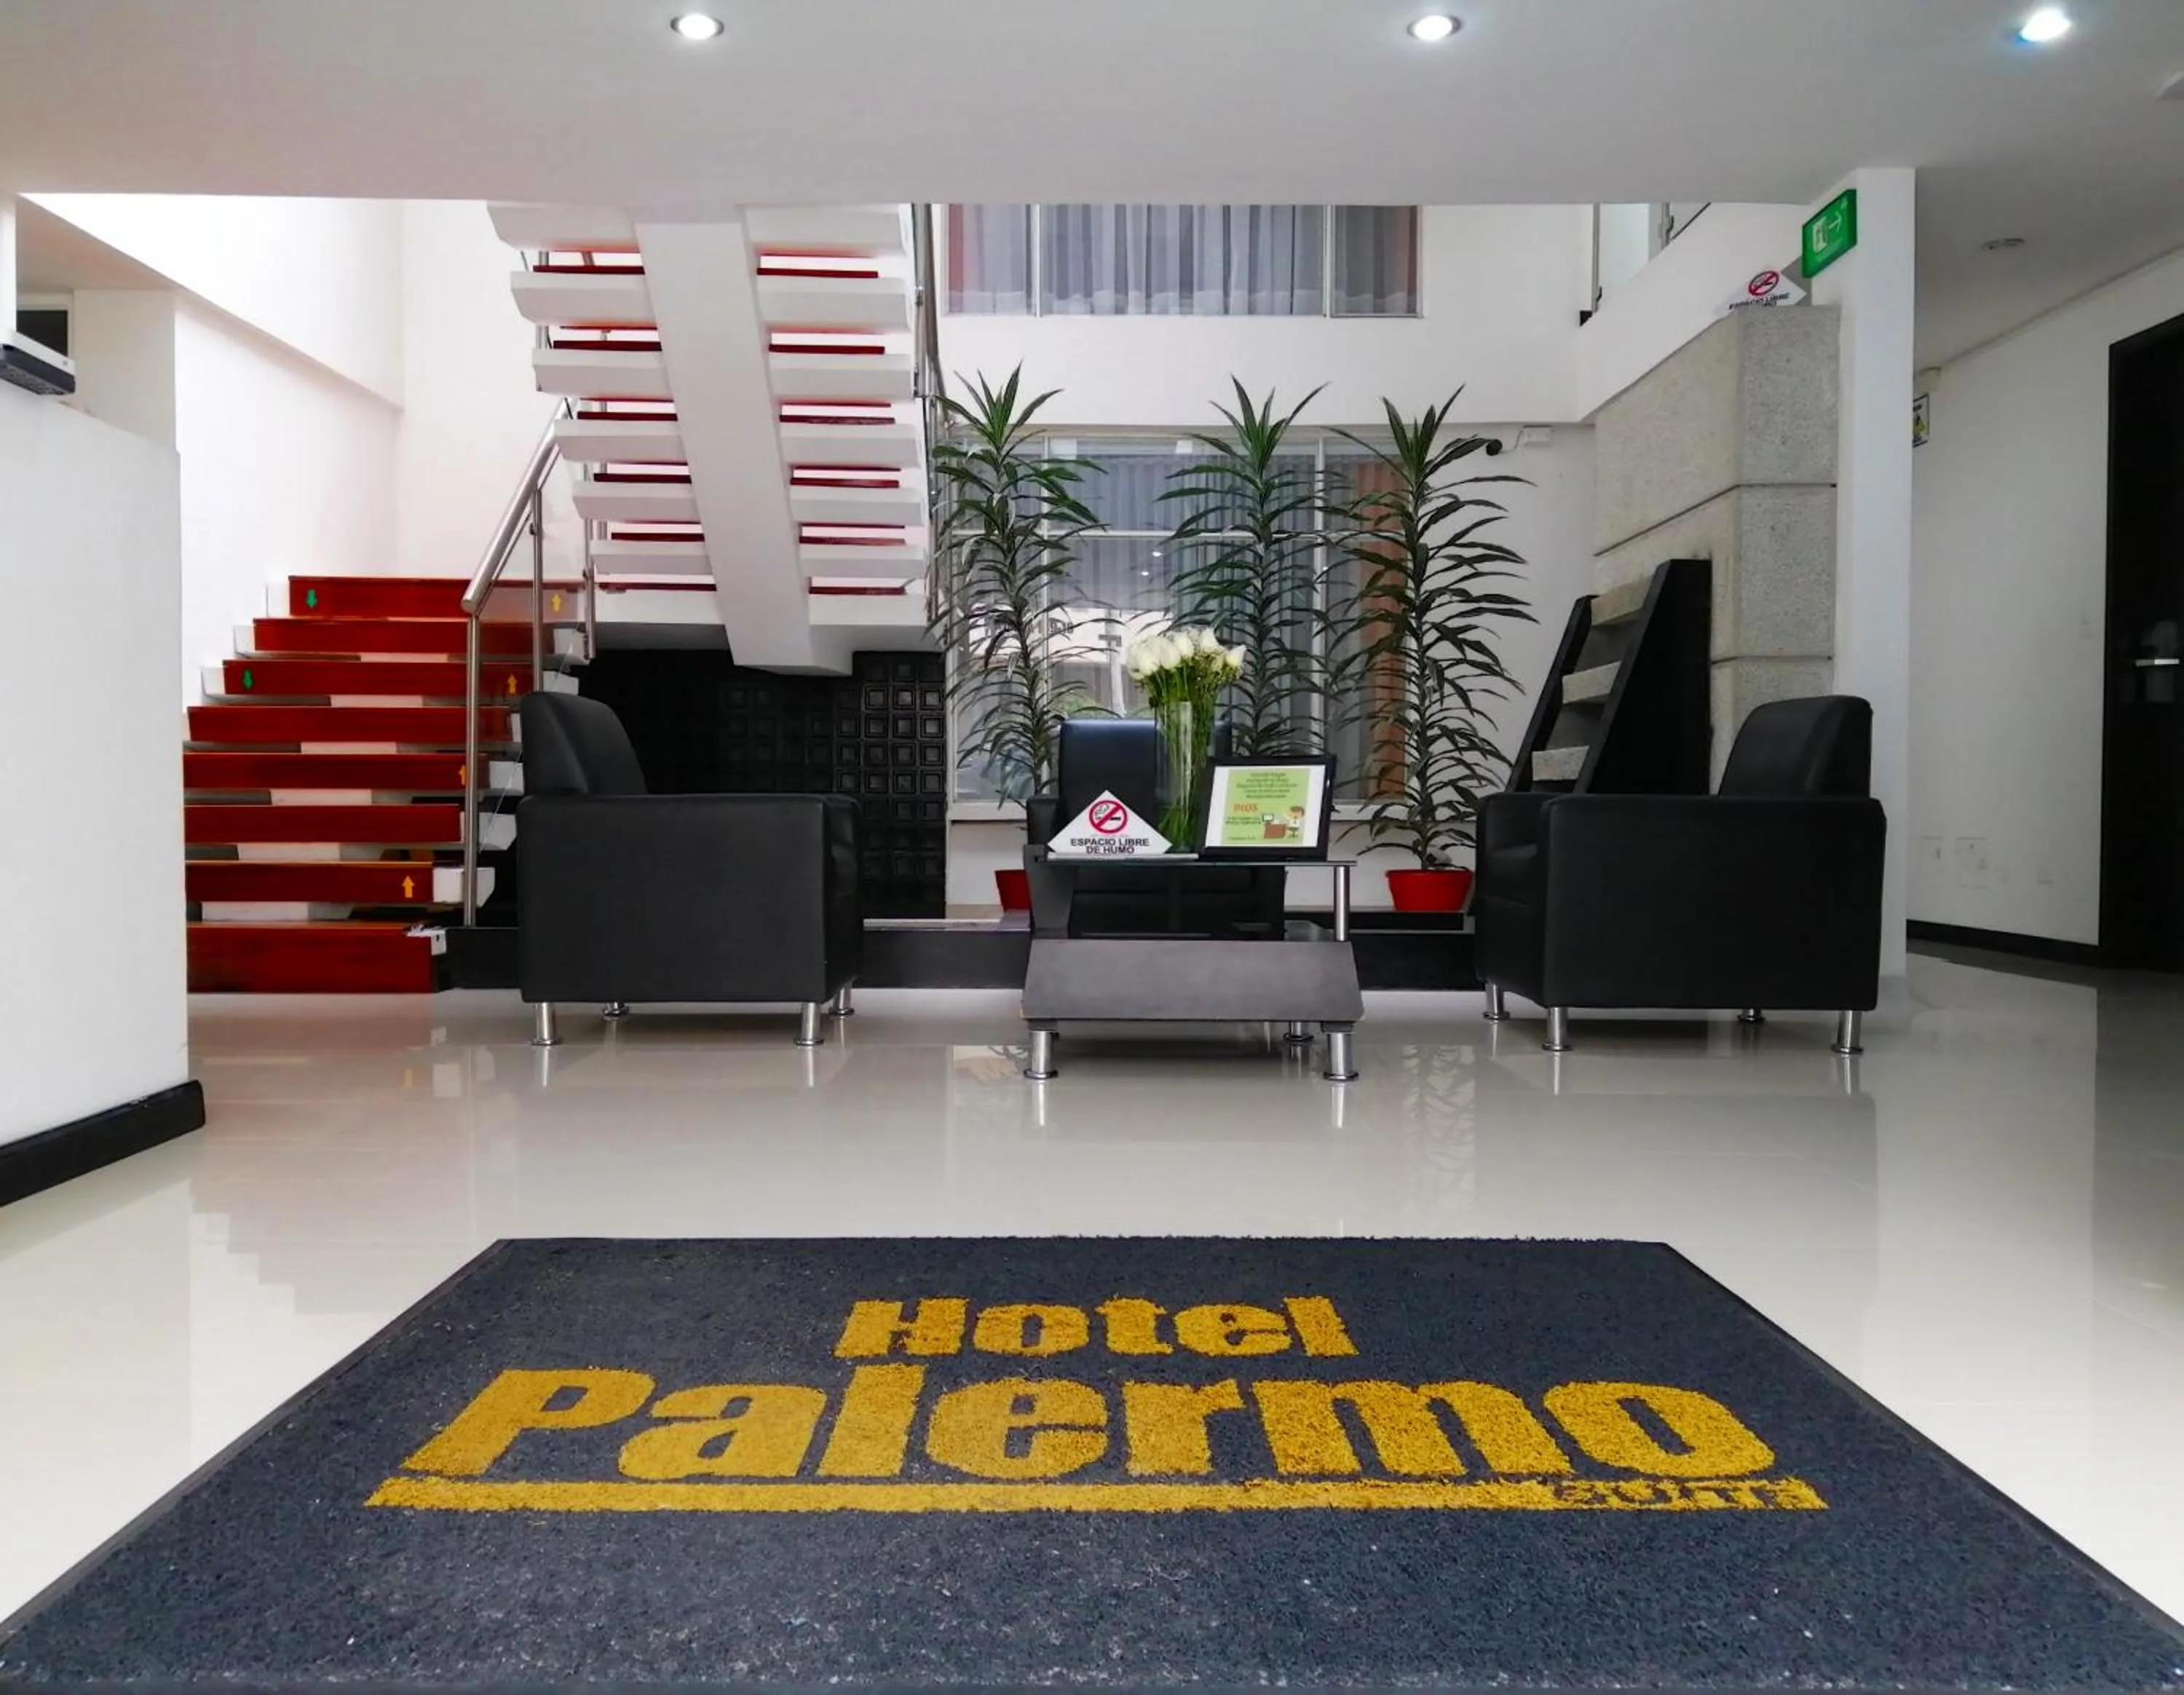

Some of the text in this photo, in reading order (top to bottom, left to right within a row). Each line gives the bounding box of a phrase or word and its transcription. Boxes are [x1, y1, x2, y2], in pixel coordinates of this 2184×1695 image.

[1071, 838, 1150, 846] ESPACIO LIBRE
[1086, 846, 1135, 855] DE HUMO
[833, 1296, 1358, 1359] Hotel
[397, 1363, 1776, 1481] Palermo
